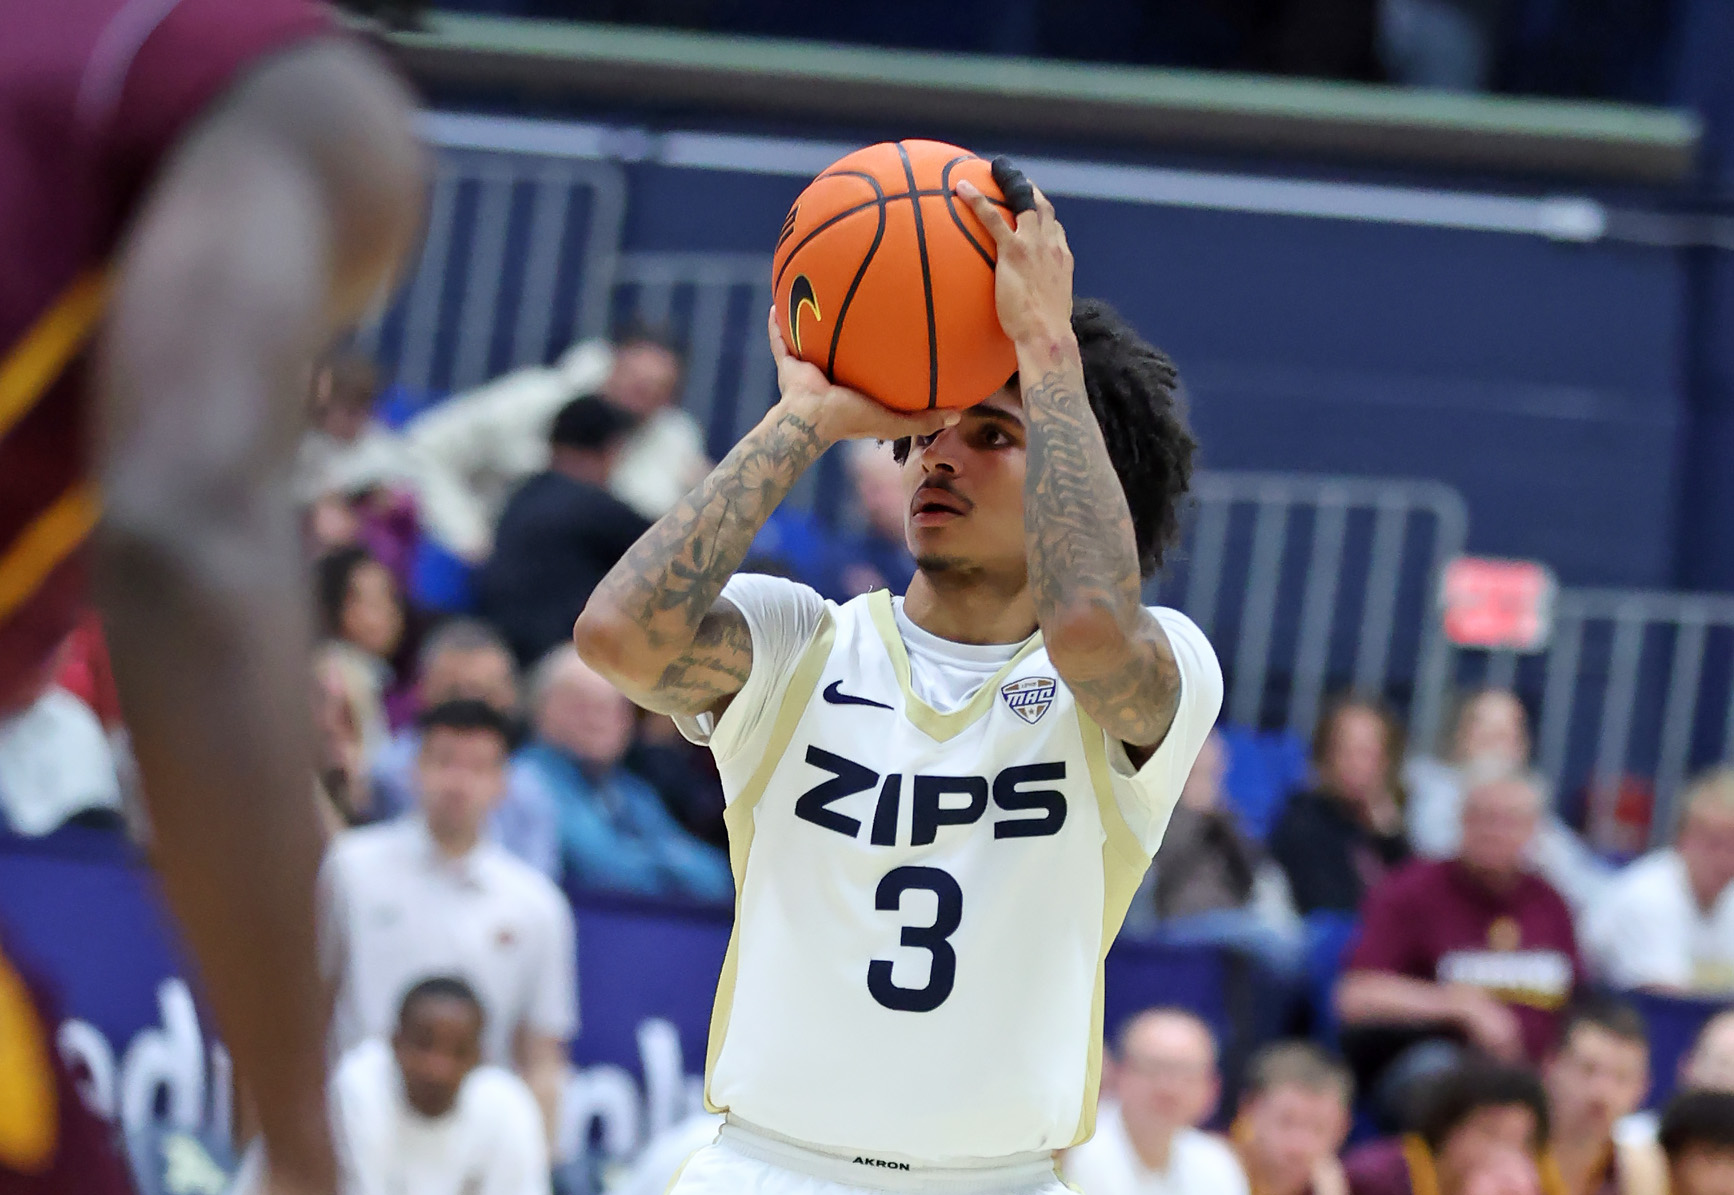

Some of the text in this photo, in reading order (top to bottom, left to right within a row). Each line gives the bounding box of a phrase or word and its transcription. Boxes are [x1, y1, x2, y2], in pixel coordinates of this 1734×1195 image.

[1005, 686, 1054, 706] MAC
[795, 744, 1068, 847] ZIPS
[867, 865, 963, 1013] 3
[852, 1156, 910, 1171] AKRON
